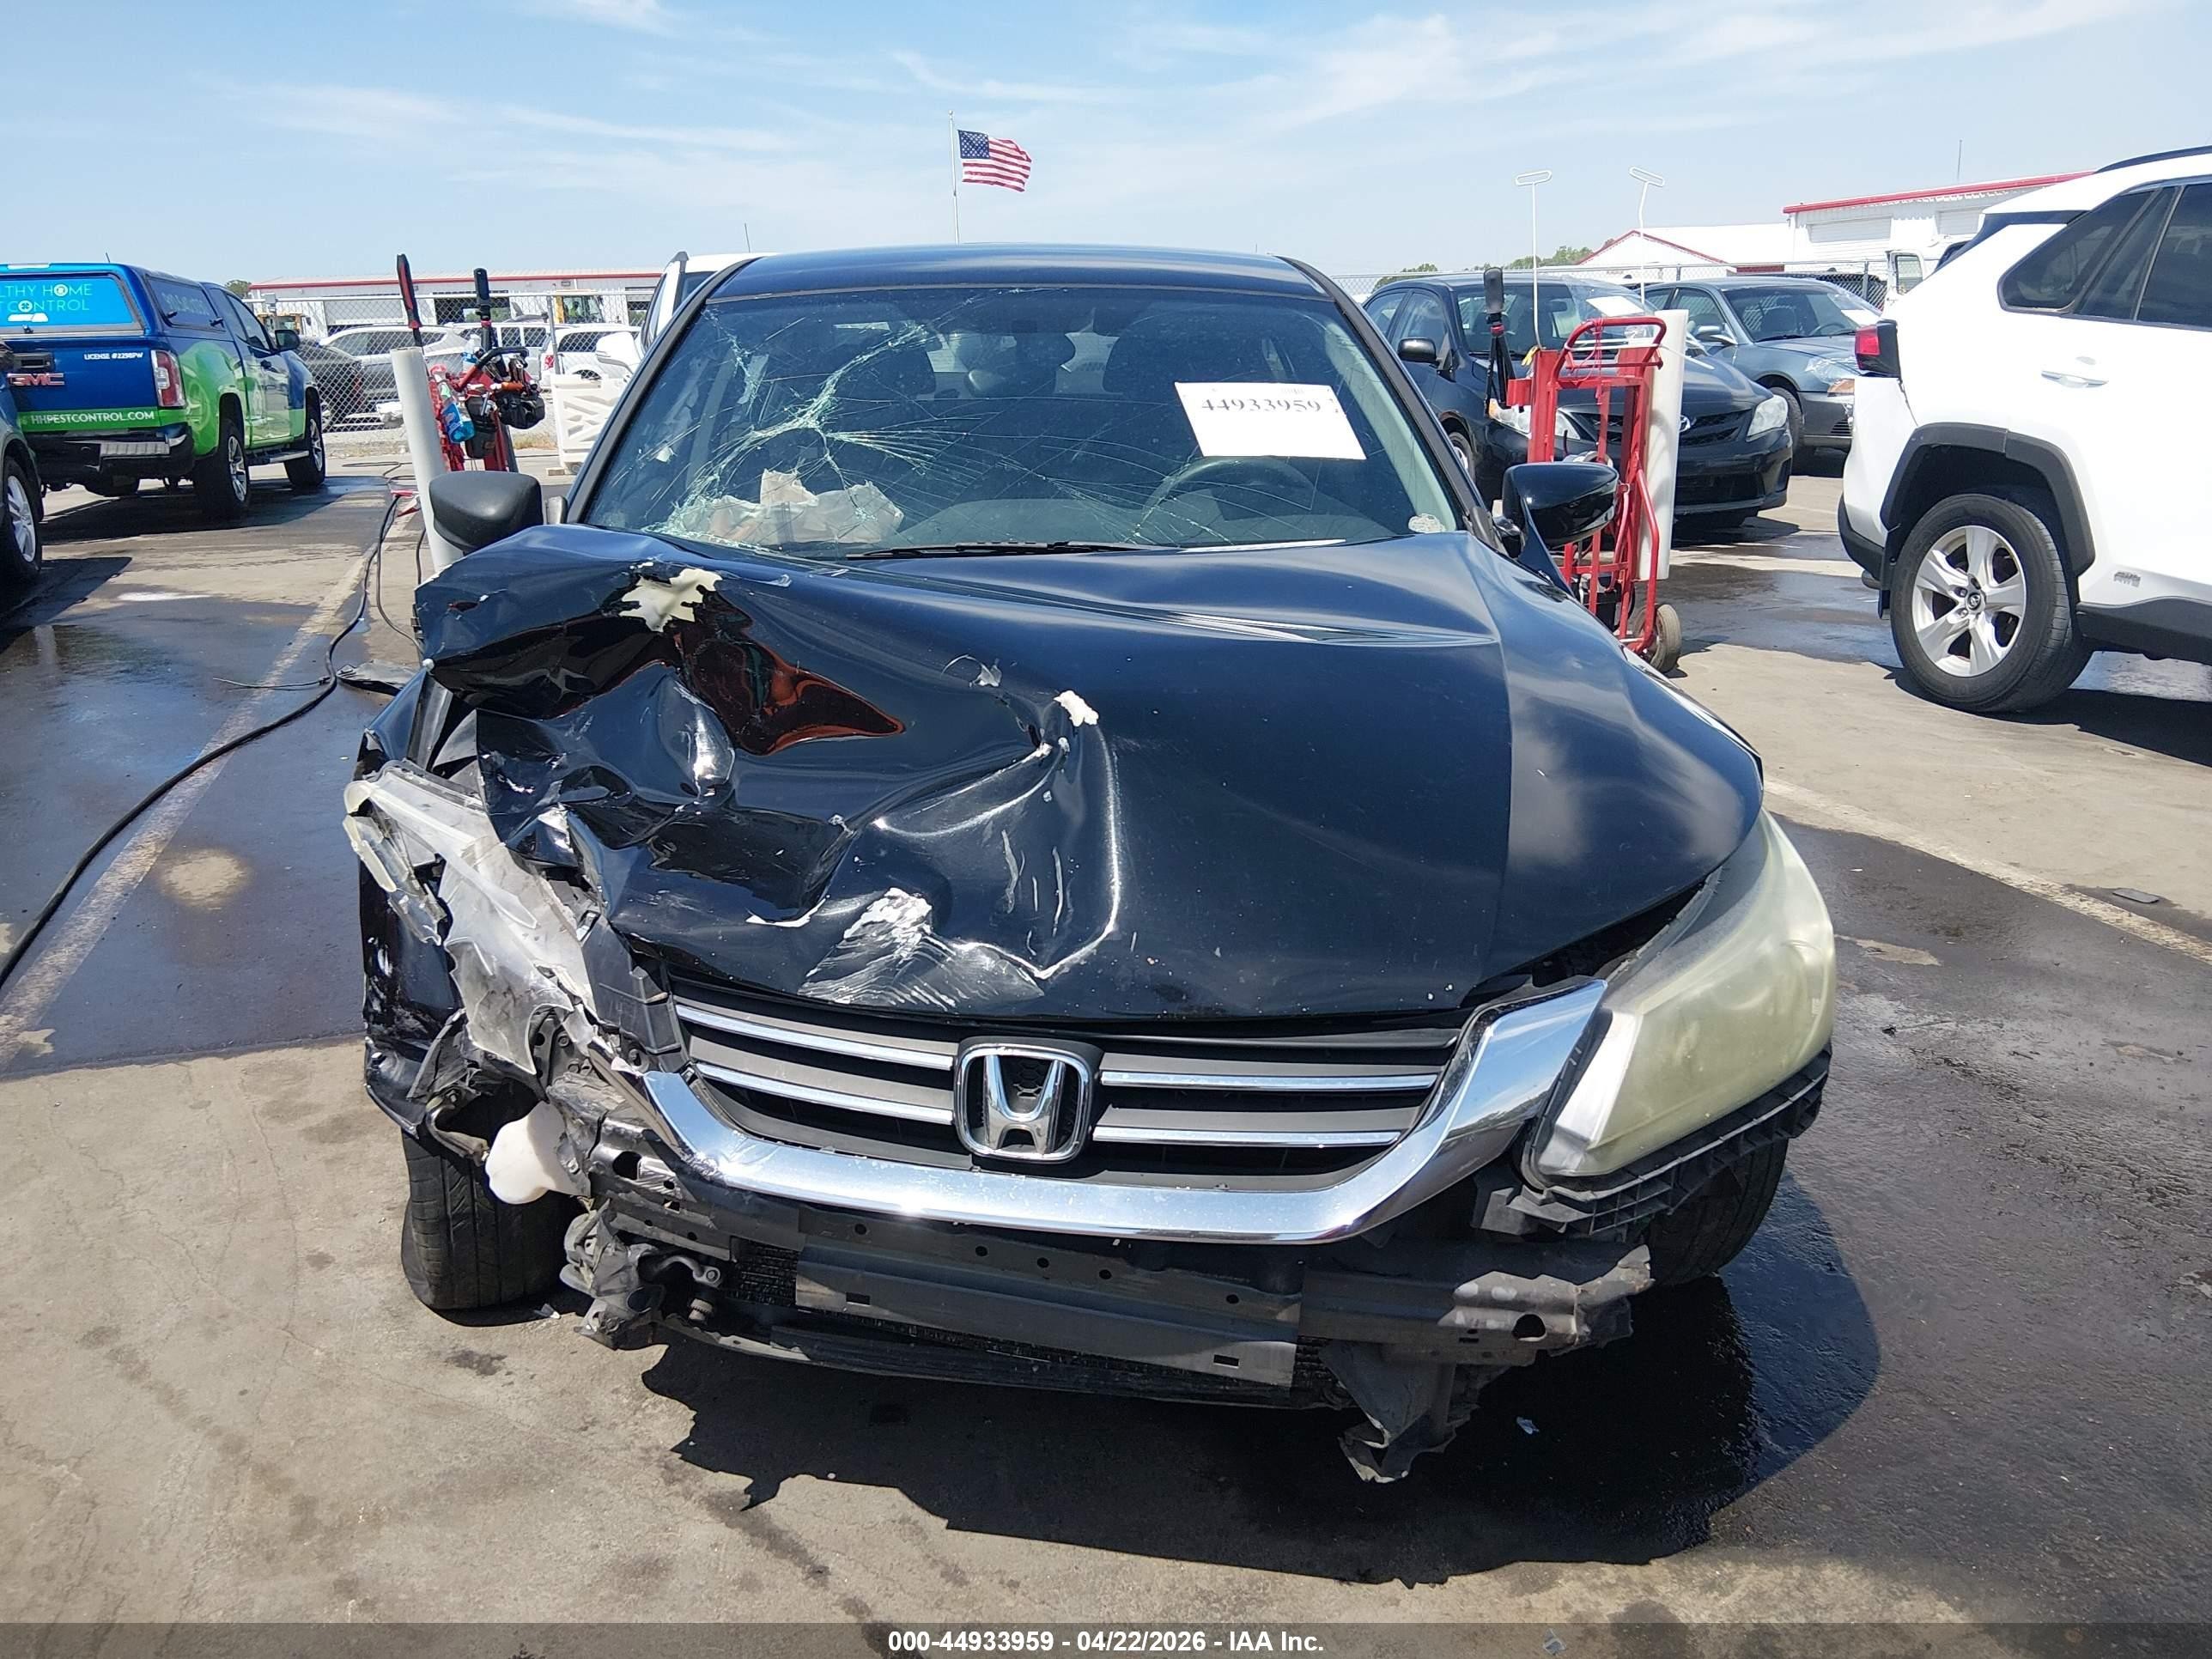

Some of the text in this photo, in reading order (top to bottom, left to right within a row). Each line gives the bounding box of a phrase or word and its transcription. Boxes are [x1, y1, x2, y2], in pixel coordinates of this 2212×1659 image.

[43, 283, 93, 296] HOME
[7, 299, 89, 312] CONTROL
[8, 373, 65, 386] GMC
[1200, 398, 1322, 412] 44933959
[31, 411, 155, 424] HHPESTCONTROL.COM
